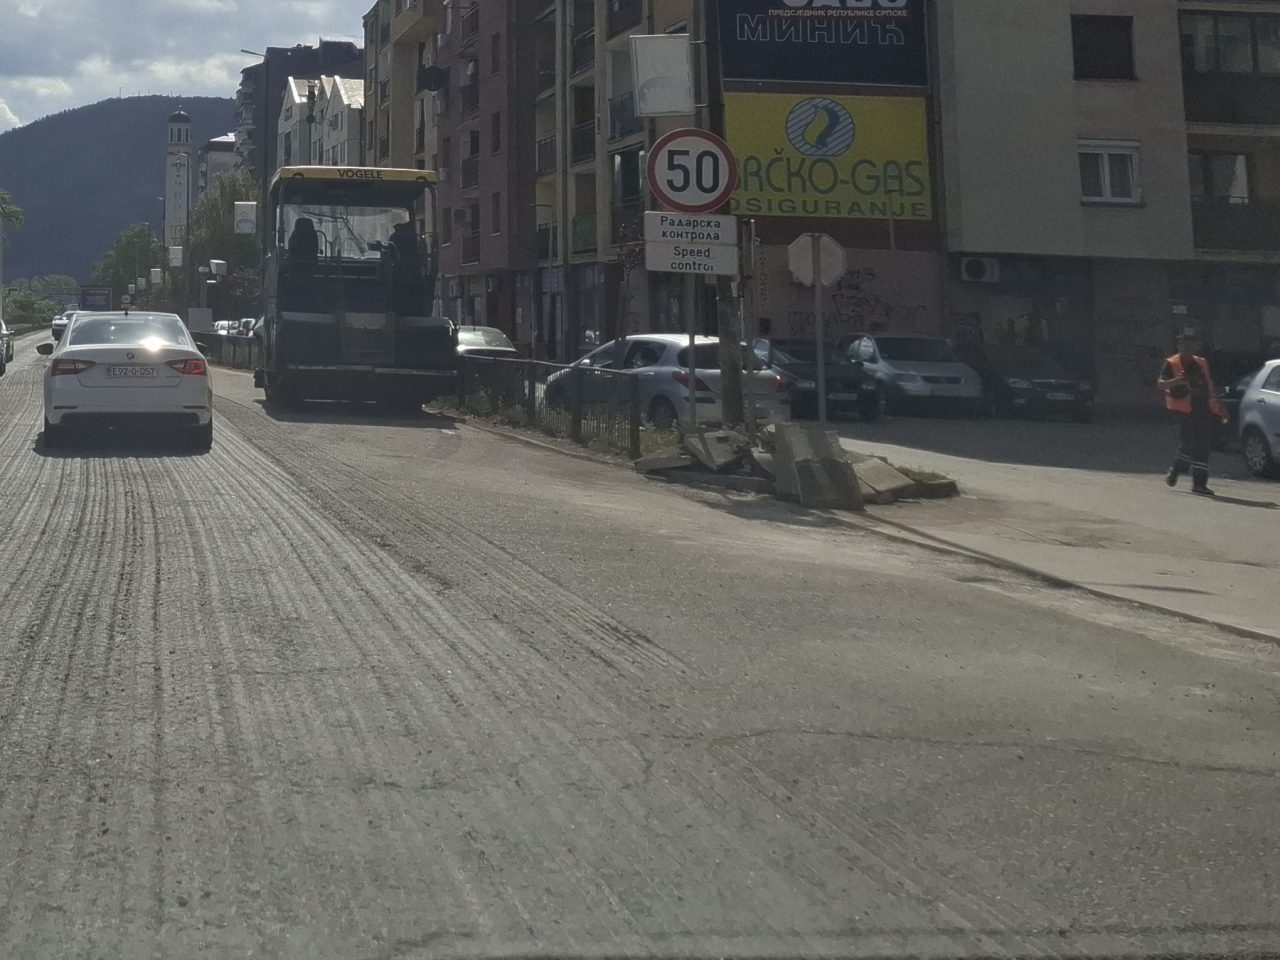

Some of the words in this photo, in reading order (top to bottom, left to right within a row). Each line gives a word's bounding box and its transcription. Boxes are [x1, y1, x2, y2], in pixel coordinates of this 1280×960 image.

[666, 149, 720, 194] 50
[736, 147, 926, 197] RČKO-GAS
[660, 215, 721, 229] Радарска
[661, 230, 721, 242] контрола
[673, 245, 711, 259] Speed
